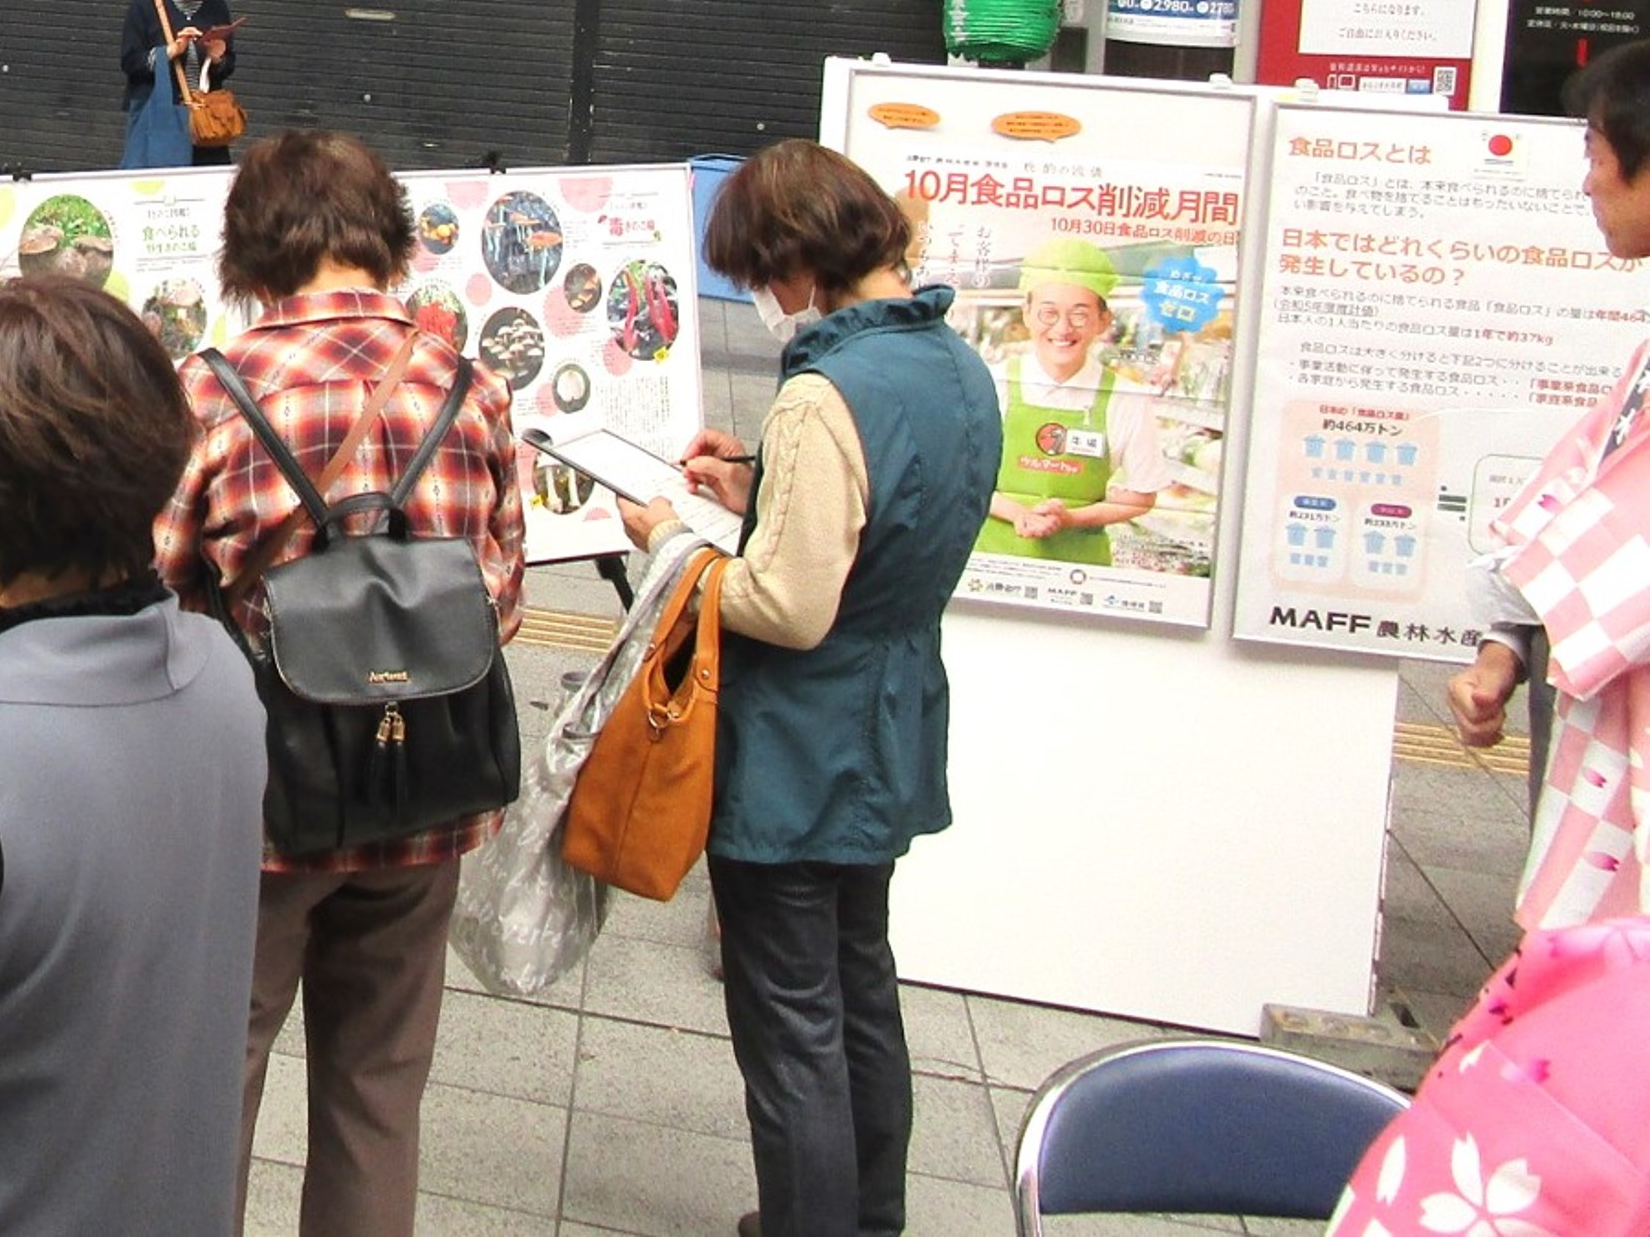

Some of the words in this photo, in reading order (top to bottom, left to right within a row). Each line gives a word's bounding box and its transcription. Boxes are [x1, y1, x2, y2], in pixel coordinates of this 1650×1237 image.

[1353, 2, 1425, 16] こちらになります。
[1287, 136, 1432, 166] 食品ロスとは
[904, 169, 1239, 227] 10月食品ロス削減月間
[1050, 217, 1236, 246] 10月30日食品ロス削減の日
[1282, 228, 1643, 273] 日本ではどれくらいの食品ロスが
[1278, 253, 1465, 286] 発生しているの？
[1154, 279, 1210, 305] 食品ロス
[1159, 300, 1197, 323] ゼロ
[1322, 418, 1403, 437] 約464万トン
[1269, 605, 1372, 634] MAFF
